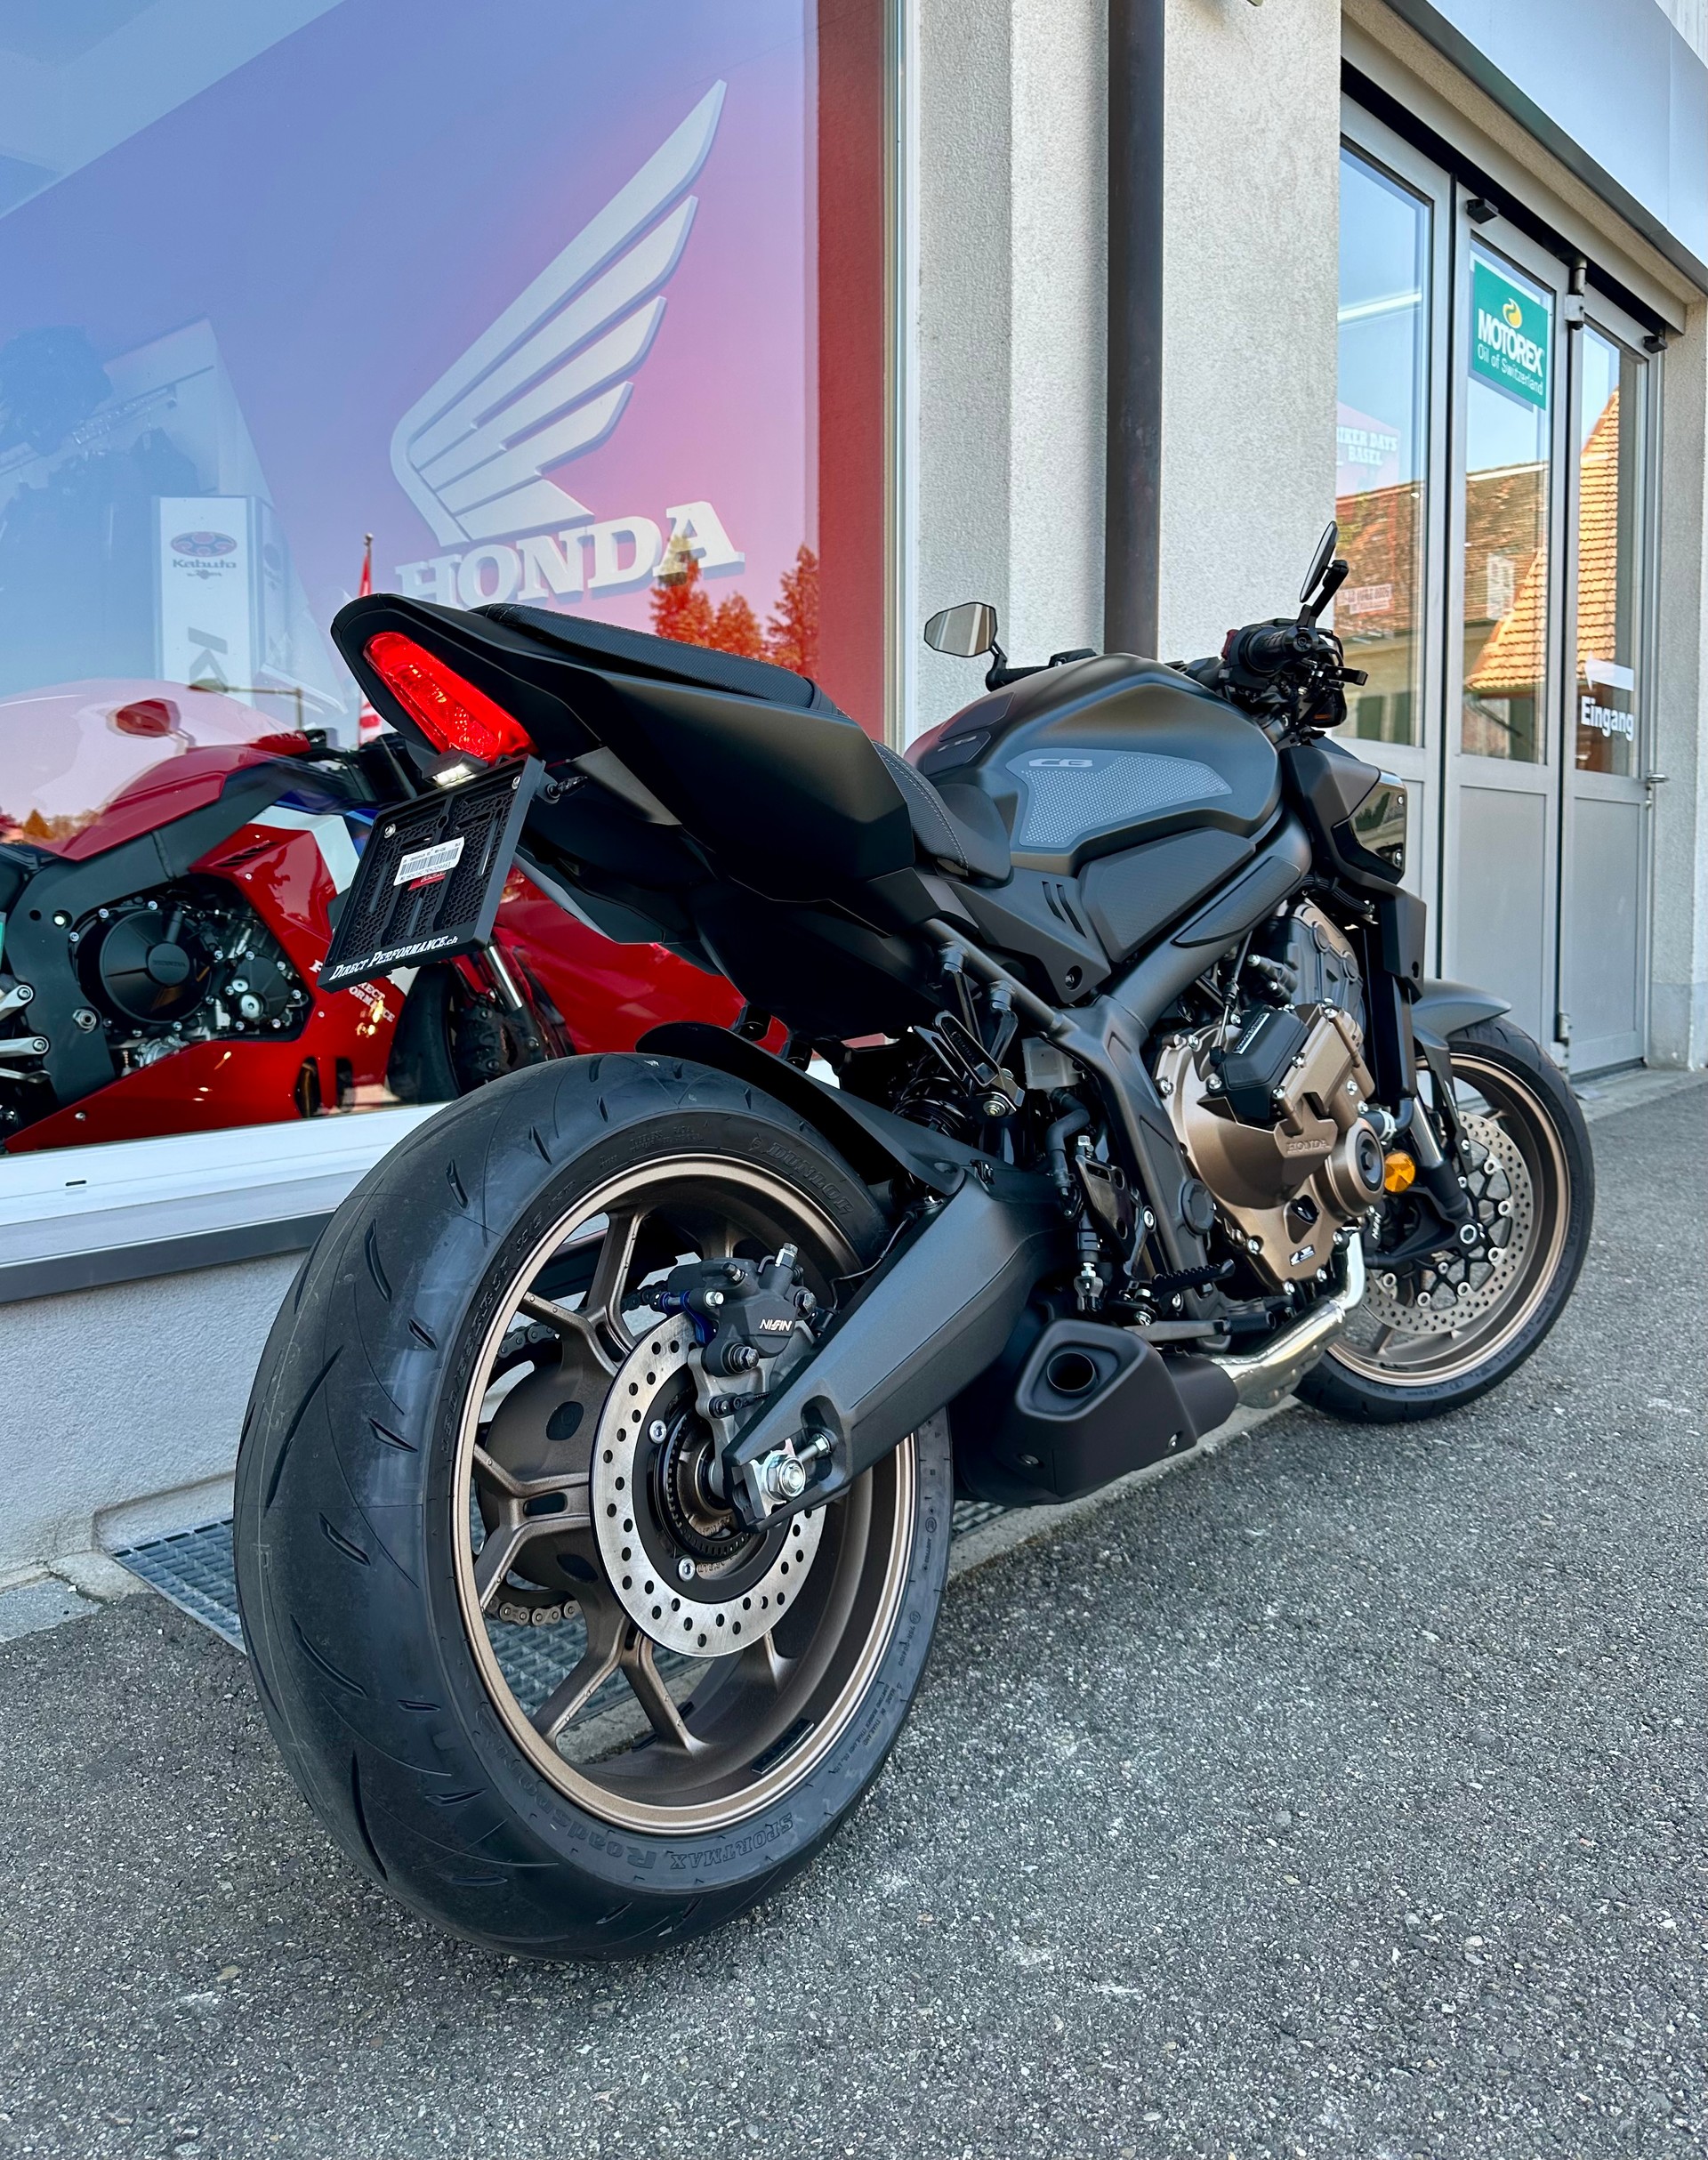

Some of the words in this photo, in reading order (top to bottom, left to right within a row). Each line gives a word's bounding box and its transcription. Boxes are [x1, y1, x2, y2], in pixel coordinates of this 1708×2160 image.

[1478, 308, 1544, 377] MOTOREX
[1477, 343, 1490, 364] Oil
[1491, 353, 1500, 369] of
[1501, 358, 1544, 396] Switzerland
[1336, 427, 1368, 447] IKER
[1369, 431, 1398, 452] DAYS
[1348, 446, 1384, 466] BASEL
[173, 559, 237, 568] Kabuto
[395, 501, 745, 609] HONDA
[1581, 696, 1634, 741] Eingang
[1028, 758, 1093, 768] CB
[329, 959, 369, 980] DIRECT
[367, 936, 458, 968] PERFORMANCE.ch
[1286, 1139, 1332, 1154] HONDA
[767, 1142, 855, 1213] DUNLOP
[670, 1812, 794, 1869] SPORTMAX
